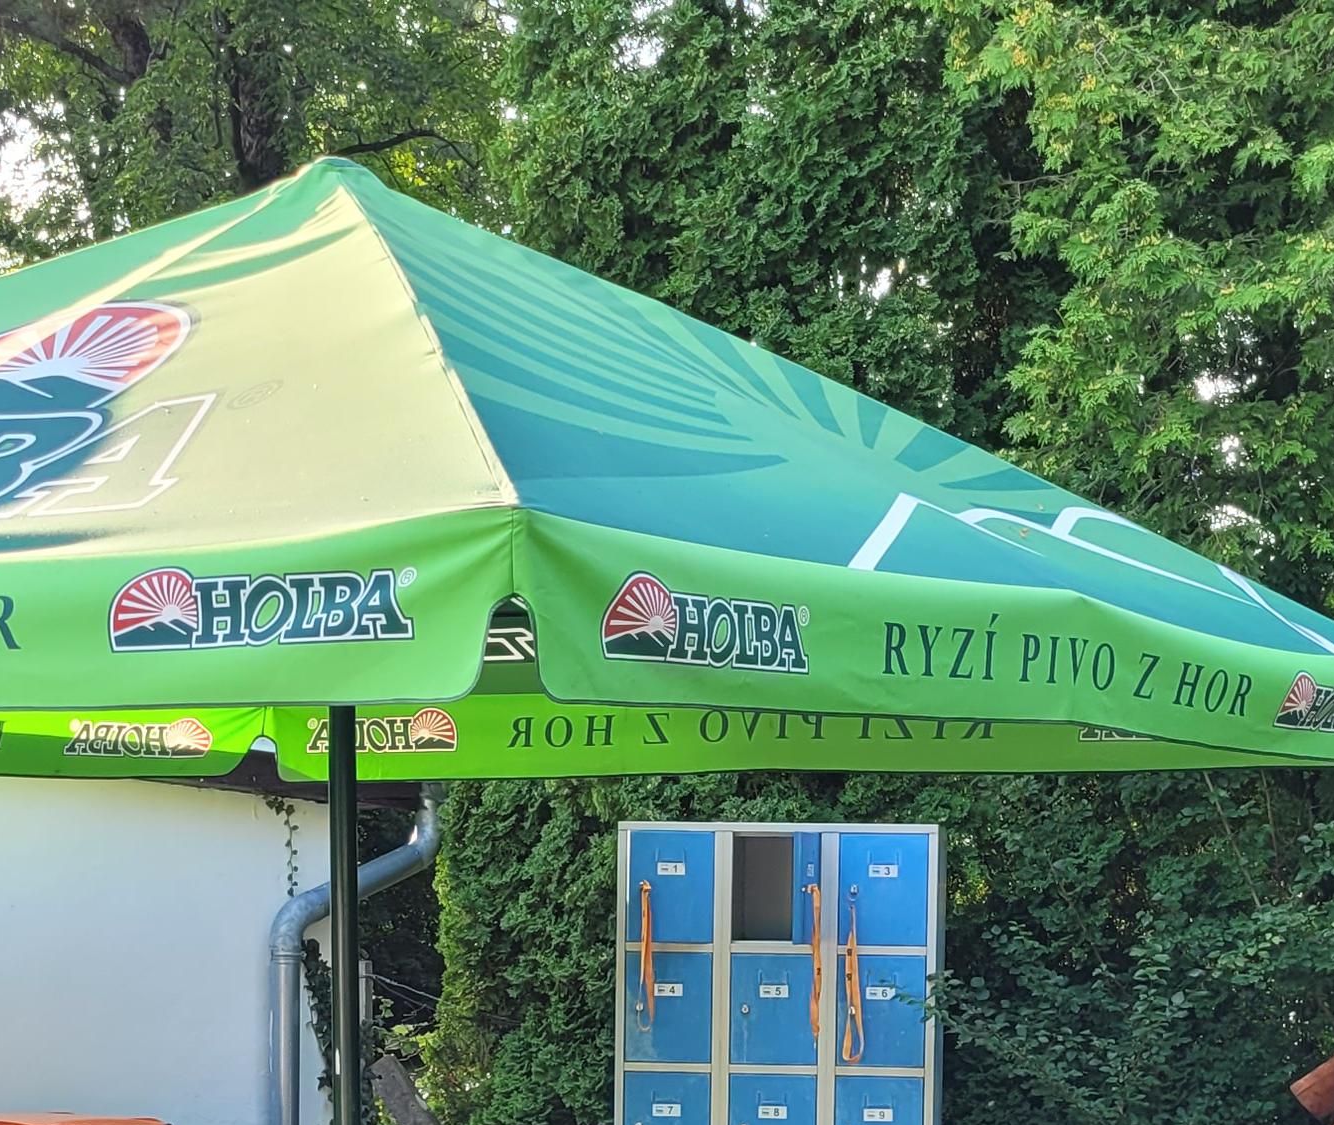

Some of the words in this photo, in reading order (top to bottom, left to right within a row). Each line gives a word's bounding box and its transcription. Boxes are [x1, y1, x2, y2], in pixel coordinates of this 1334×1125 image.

[192, 569, 415, 649] HOLBA
[667, 594, 810, 676] HOLBA
[882, 612, 1000, 681] RYZÍ
[1019, 632, 1117, 692] PIVO
[1132, 652, 1162, 700] Z
[1175, 660, 1256, 717] HOR
[884, 866, 890, 876] 3
[669, 985, 676, 995] 4
[775, 986, 782, 996] 5
[881, 988, 888, 998] 6
[667, 1106, 673, 1115] 7
[773, 1107, 780, 1117] 8
[879, 1110, 885, 1120] 9
